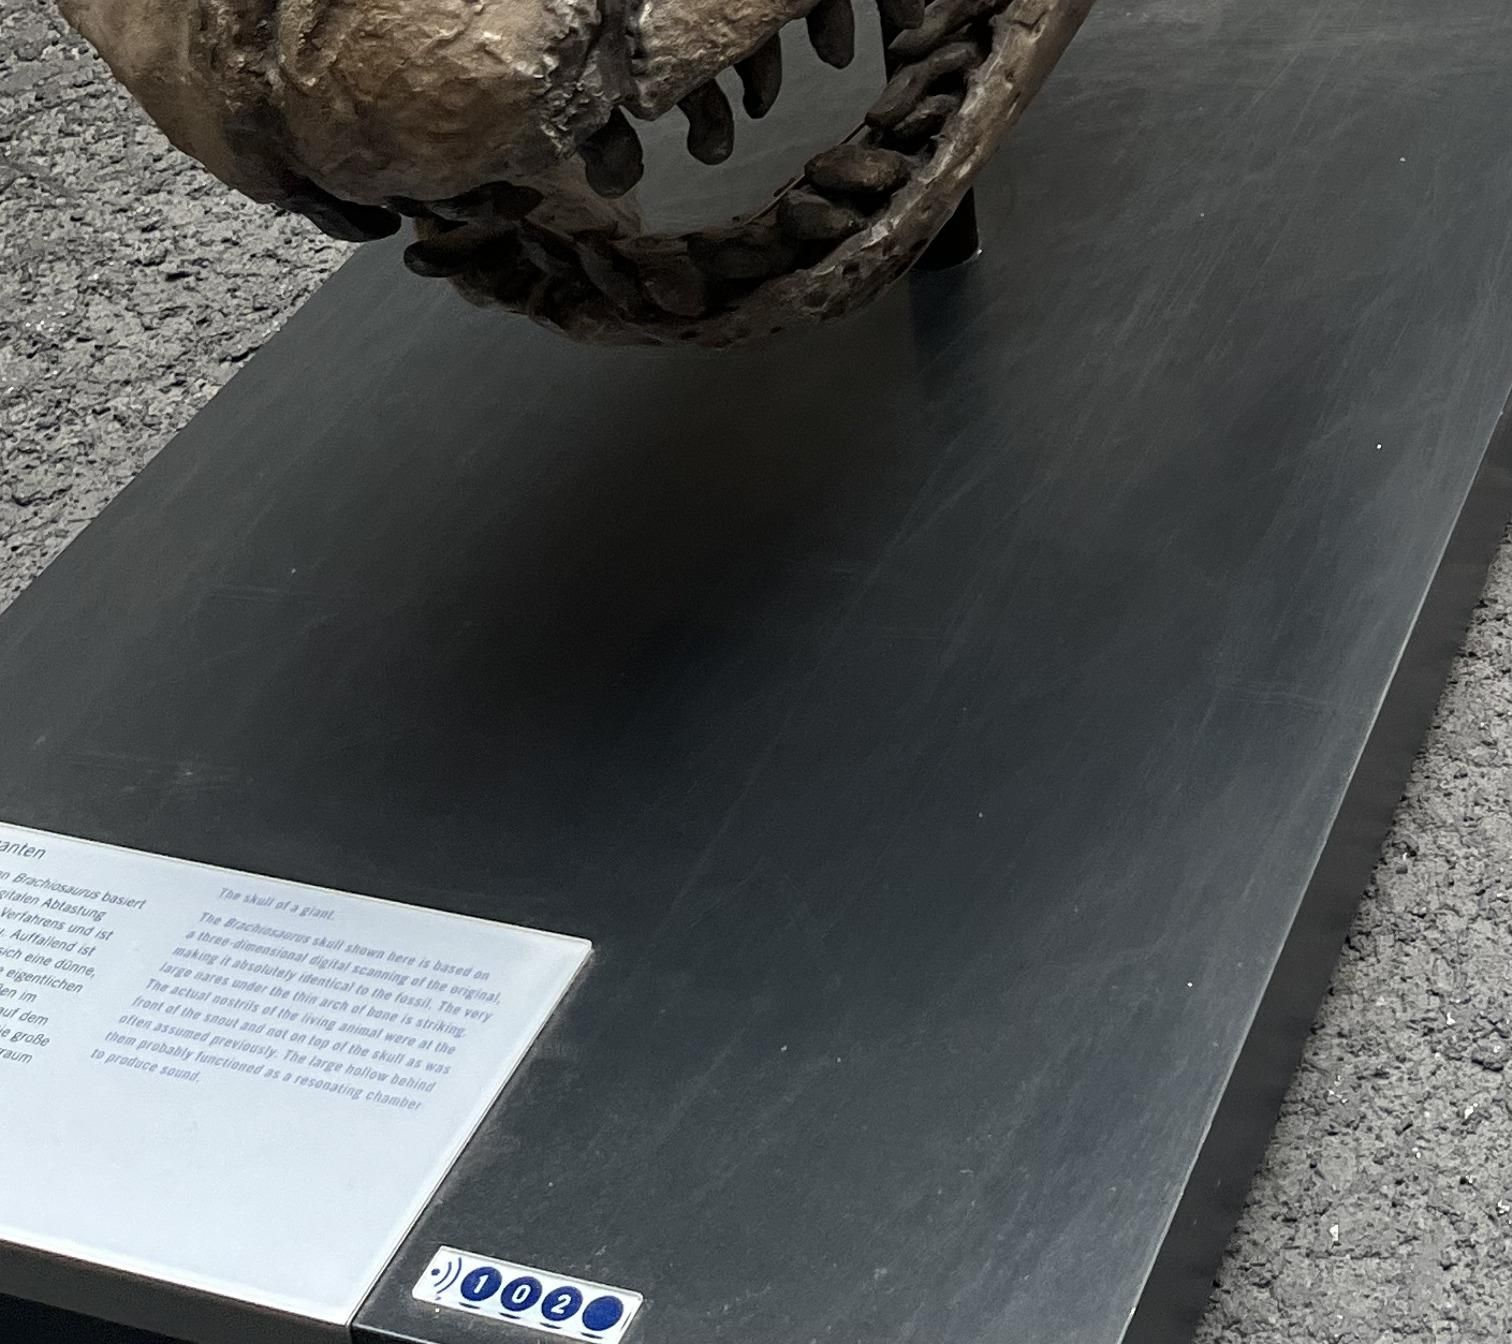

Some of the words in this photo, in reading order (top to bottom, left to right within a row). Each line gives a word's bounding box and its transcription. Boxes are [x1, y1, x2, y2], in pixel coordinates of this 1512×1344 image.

[11, 872, 100, 899] Brachiosaurus
[100, 890, 146, 909] basiert
[218, 887, 241, 900] The
[242, 893, 275, 906] skull
[298, 905, 334, 920] giant.
[39, 897, 106, 921] Abtastung
[9, 928, 78, 951] Auffallend
[76, 942, 96, 956] ist
[66, 923, 95, 936] und
[93, 928, 114, 941] ist
[199, 911, 222, 925] The
[223, 917, 310, 943] Brachiosaurus
[311, 936, 344, 950] skull
[343, 943, 384, 958] shown
[386, 950, 416, 965] here
[432, 959, 473, 976] based
[6, 968, 83, 993] eigentlichen
[23, 952, 52, 968] eine
[53, 958, 95, 978] dünne,
[197, 931, 308, 962] three-dimensional
[308, 954, 351, 971] digital
[351, 965, 410, 985] scanning
[425, 978, 448, 991] the
[449, 985, 500, 1005] original,
[17, 989, 37, 1002] im
[158, 961, 192, 978] large
[193, 971, 232, 985] nares
[231, 979, 268, 993] under
[268, 985, 290, 999] the
[292, 991, 319, 1004] thin
[317, 997, 349, 1011] arch
[365, 1005, 398, 1022] bone
[415, 1018, 466, 1038] striking.
[171, 947, 218, 965] making
[231, 959, 297, 981] absolutely
[297, 971, 355, 992] identical
[370, 987, 392, 1000] the
[394, 991, 432, 1010] fossil.
[437, 1000, 461, 1015] The
[463, 1008, 493, 1023] very
[17, 1010, 48, 1026] dem
[145, 977, 170, 992] The
[168, 986, 212, 1001] actual
[211, 995, 259, 1012] nostrils
[276, 1006, 299, 1021] the
[300, 1011, 336, 1031] living
[337, 1022, 383, 1039] animal
[383, 1032, 416, 1046] were
[434, 1041, 456, 1055] the
[8, 1031, 50, 1046] große
[130, 995, 165, 1011] front
[180, 1007, 202, 1020] the
[202, 1013, 239, 1028] snout
[239, 1021, 266, 1033] and
[265, 1027, 289, 1040] not
[307, 1034, 330, 1050] top
[347, 1043, 370, 1056] the
[371, 1049, 405, 1064] skull
[425, 1061, 451, 1074] was
[103, 1053, 158, 1072] produce
[159, 1065, 200, 1083] sound.
[117, 1014, 152, 1029] often
[152, 1022, 211, 1041] assumed
[208, 1035, 277, 1059] previously.
[282, 1048, 307, 1064] The
[307, 1055, 343, 1073] large
[344, 1063, 389, 1081] hollow
[389, 1073, 436, 1092] behind
[104, 1031, 136, 1046] them
[135, 1039, 194, 1061] probably
[194, 1050, 264, 1074] functioned
[293, 1075, 363, 1099] resonating
[365, 1090, 421, 1110] chamber
